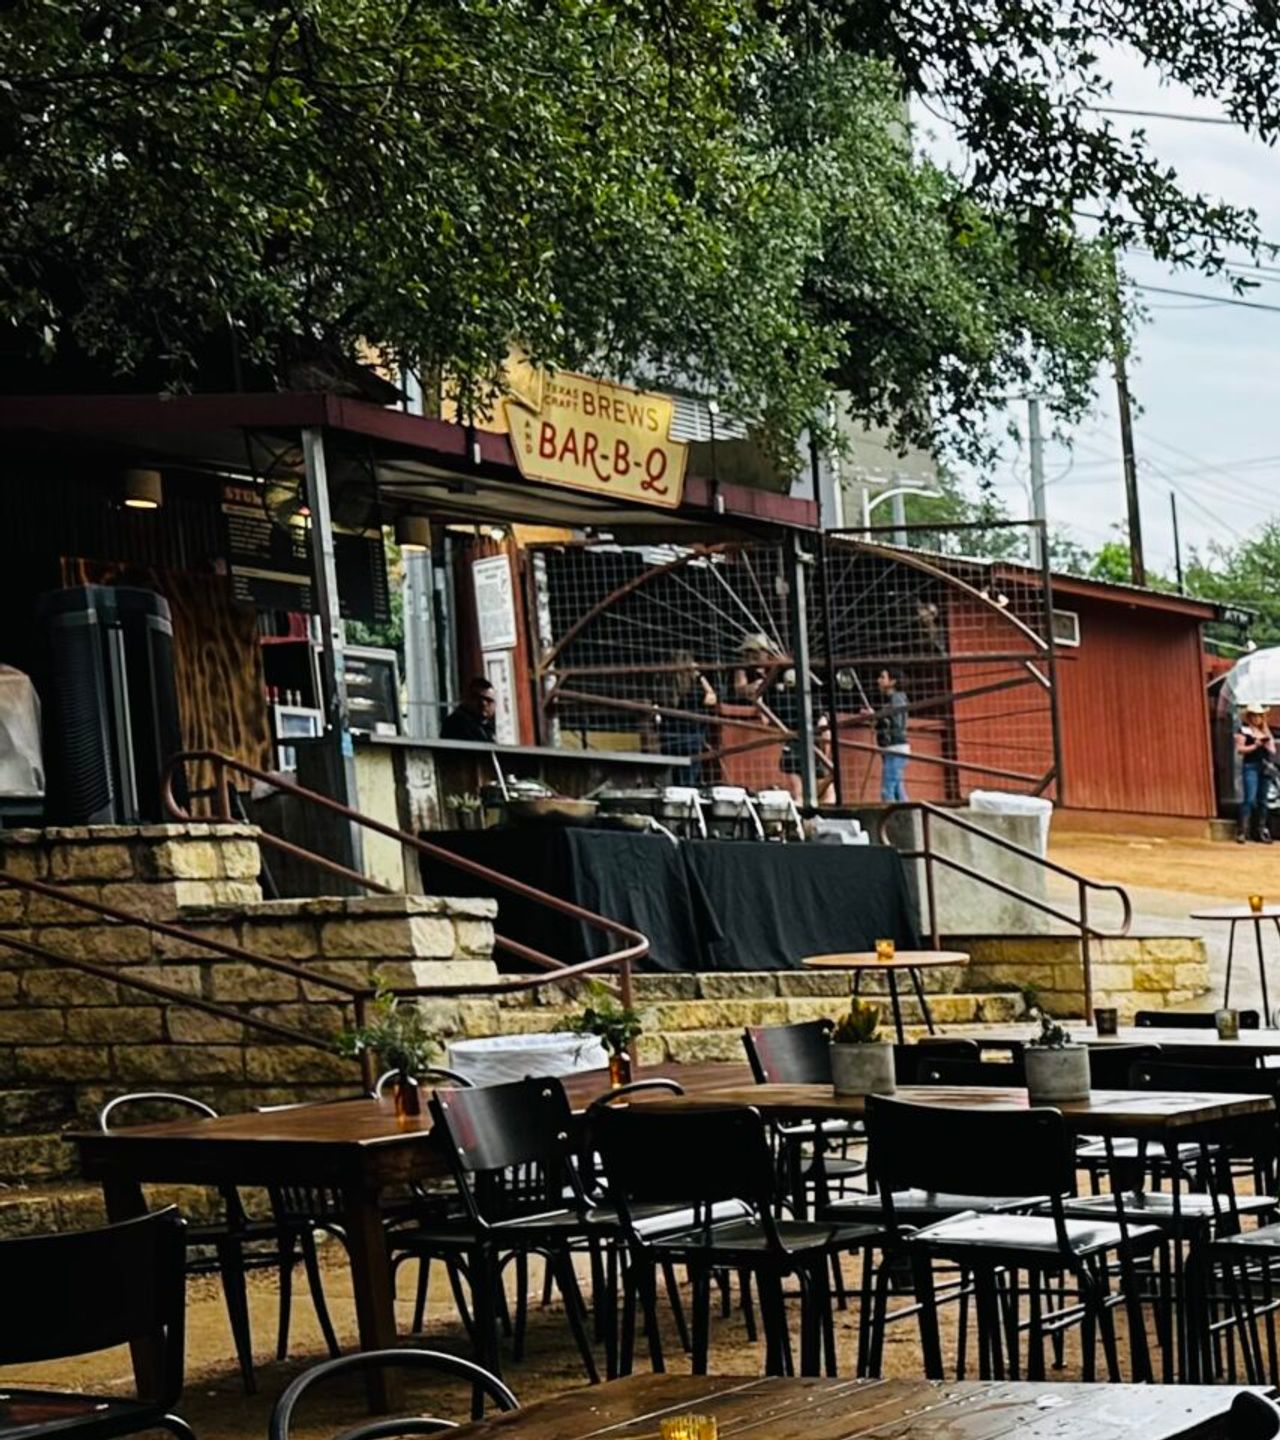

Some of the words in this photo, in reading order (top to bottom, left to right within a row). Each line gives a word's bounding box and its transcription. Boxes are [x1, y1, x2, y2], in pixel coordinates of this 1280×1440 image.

[543, 395, 578, 412] CRAFT
[545, 382, 579, 399] TEXAS
[582, 391, 659, 432] BREWS
[524, 419, 533, 455] AND
[539, 421, 668, 495] BAR-B-Q
